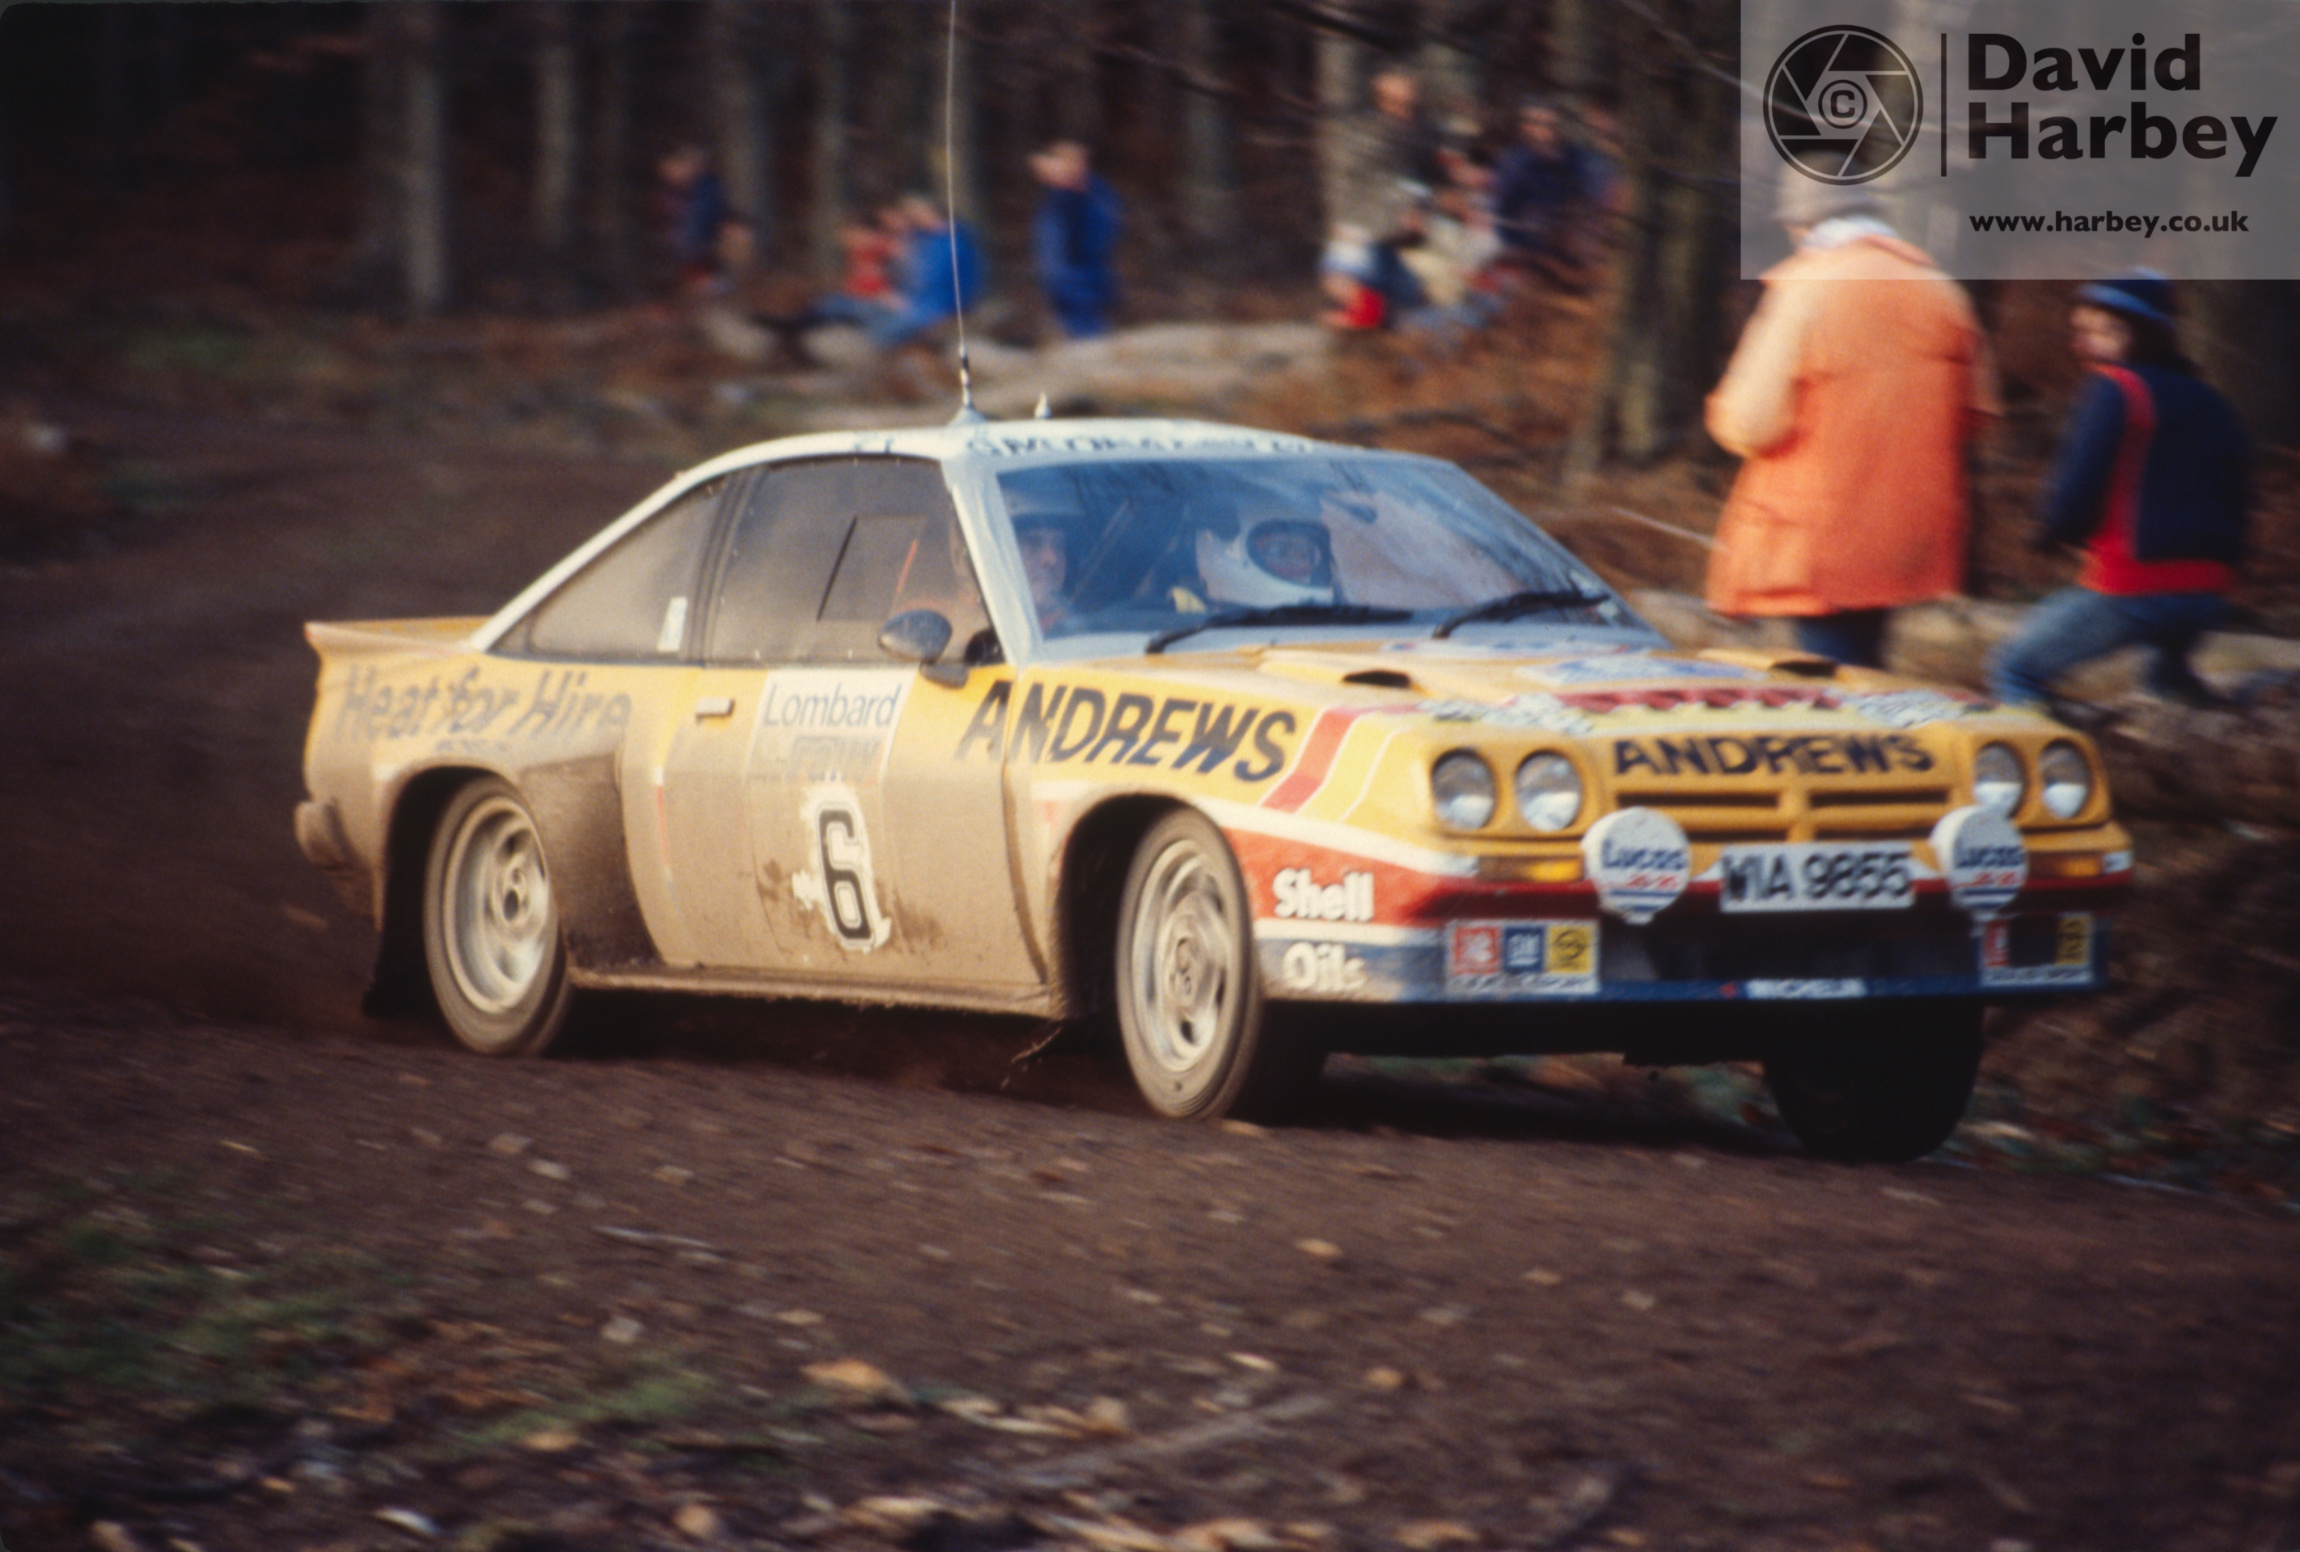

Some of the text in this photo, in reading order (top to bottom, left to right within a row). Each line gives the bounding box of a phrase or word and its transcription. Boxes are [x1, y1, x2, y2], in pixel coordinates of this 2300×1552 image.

[337, 665, 632, 742] Heat for Hire
[763, 683, 902, 727] Lombard
[952, 680, 1297, 783] ANDREWS
[1612, 733, 1935, 776] ANDREWS
[815, 807, 874, 941] 6
[1272, 867, 1374, 922] Shell
[1803, 851, 1912, 900] 9855
